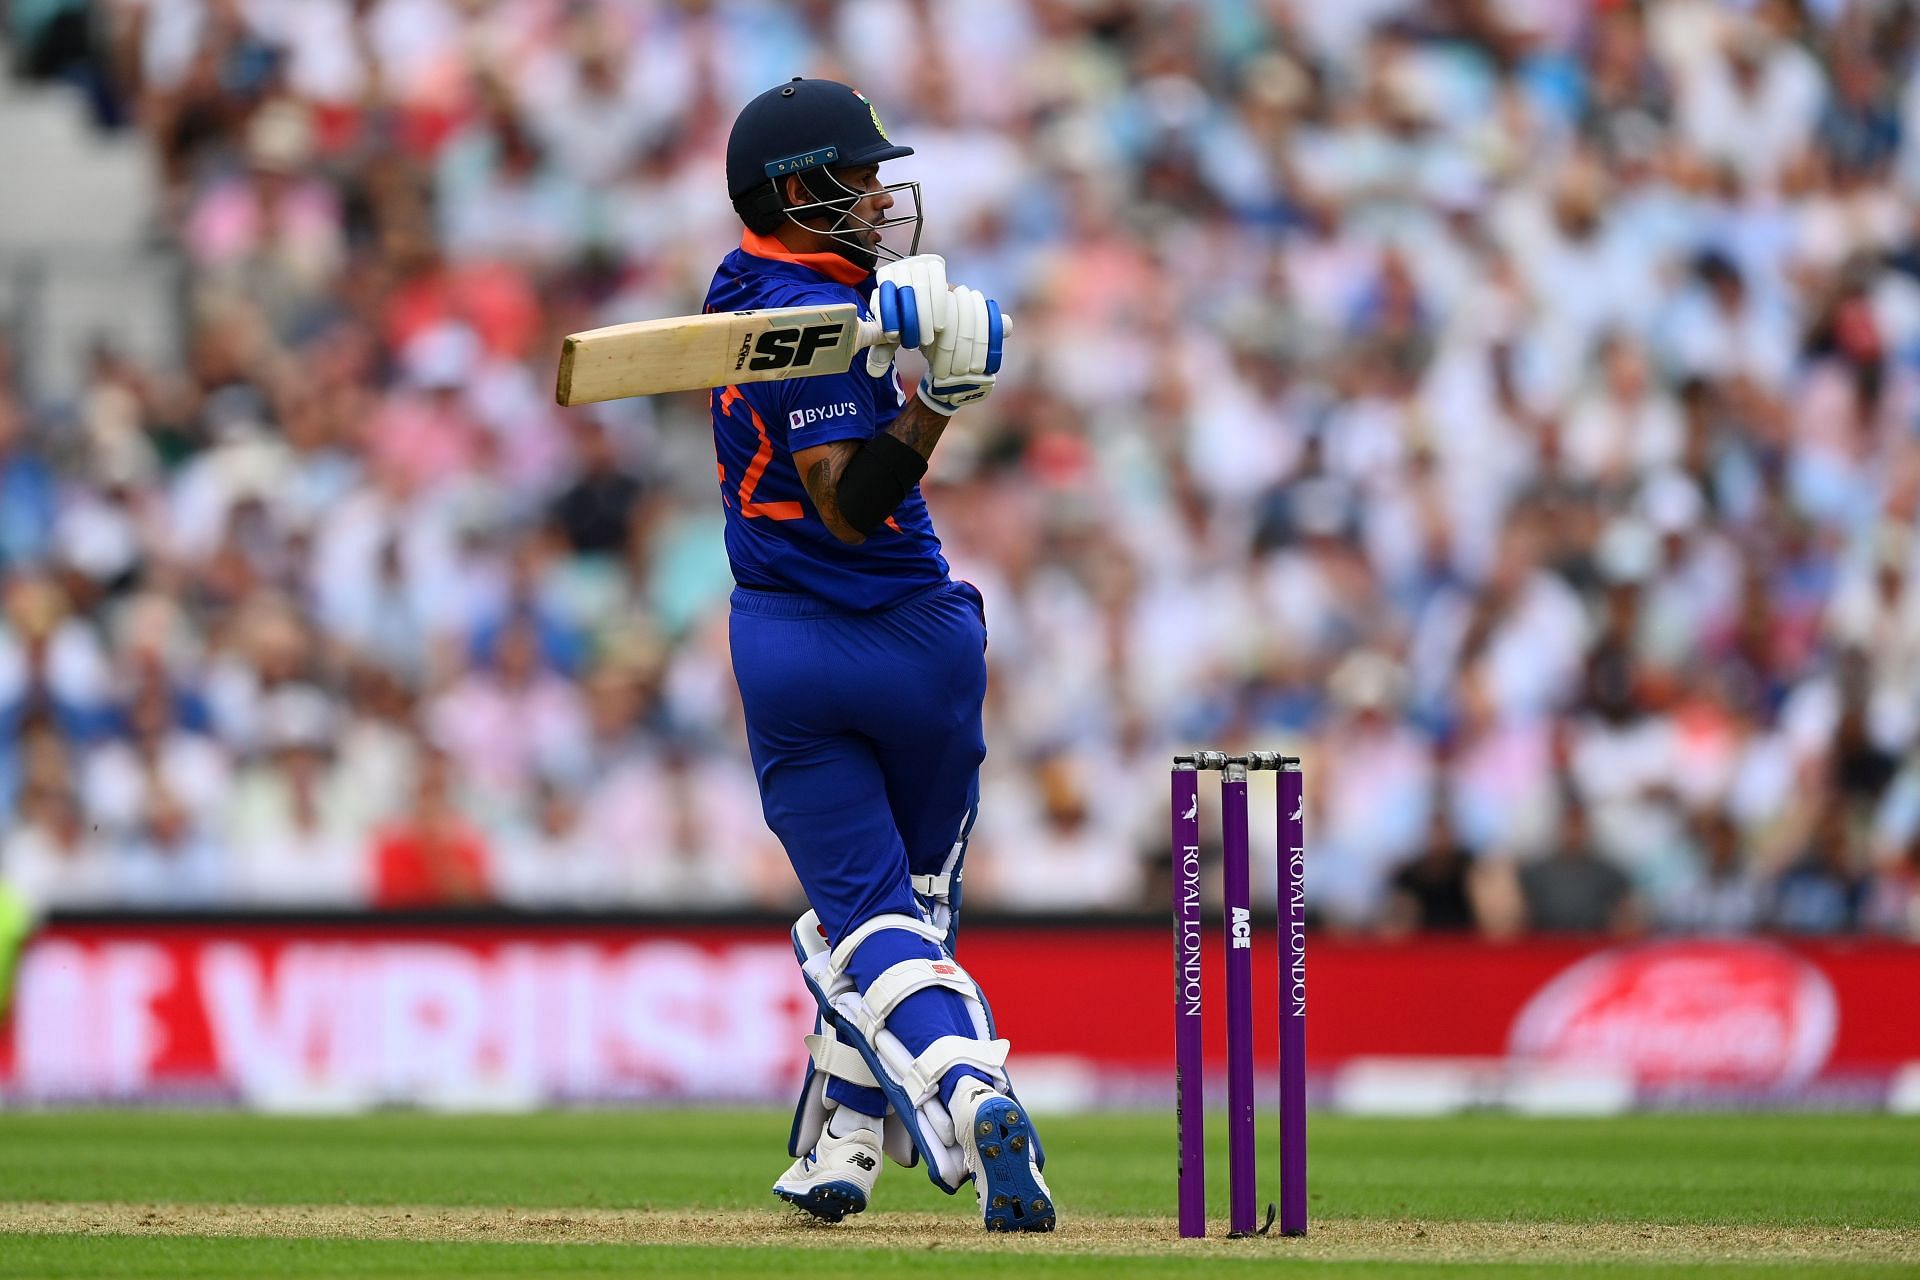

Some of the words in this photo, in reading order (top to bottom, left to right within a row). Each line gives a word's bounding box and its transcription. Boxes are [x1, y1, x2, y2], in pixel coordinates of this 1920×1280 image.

[790, 155, 815, 170] AIR
[748, 323, 844, 371] SF
[805, 402, 857, 423] BYJU'S
[710, 384, 804, 520] 2
[1183, 845, 1200, 914] ROYAL
[1290, 847, 1304, 915] ROYAL
[1231, 906, 1250, 949] ACE
[1184, 920, 1201, 1016] LONDON
[1291, 922, 1306, 1017] LONDON
